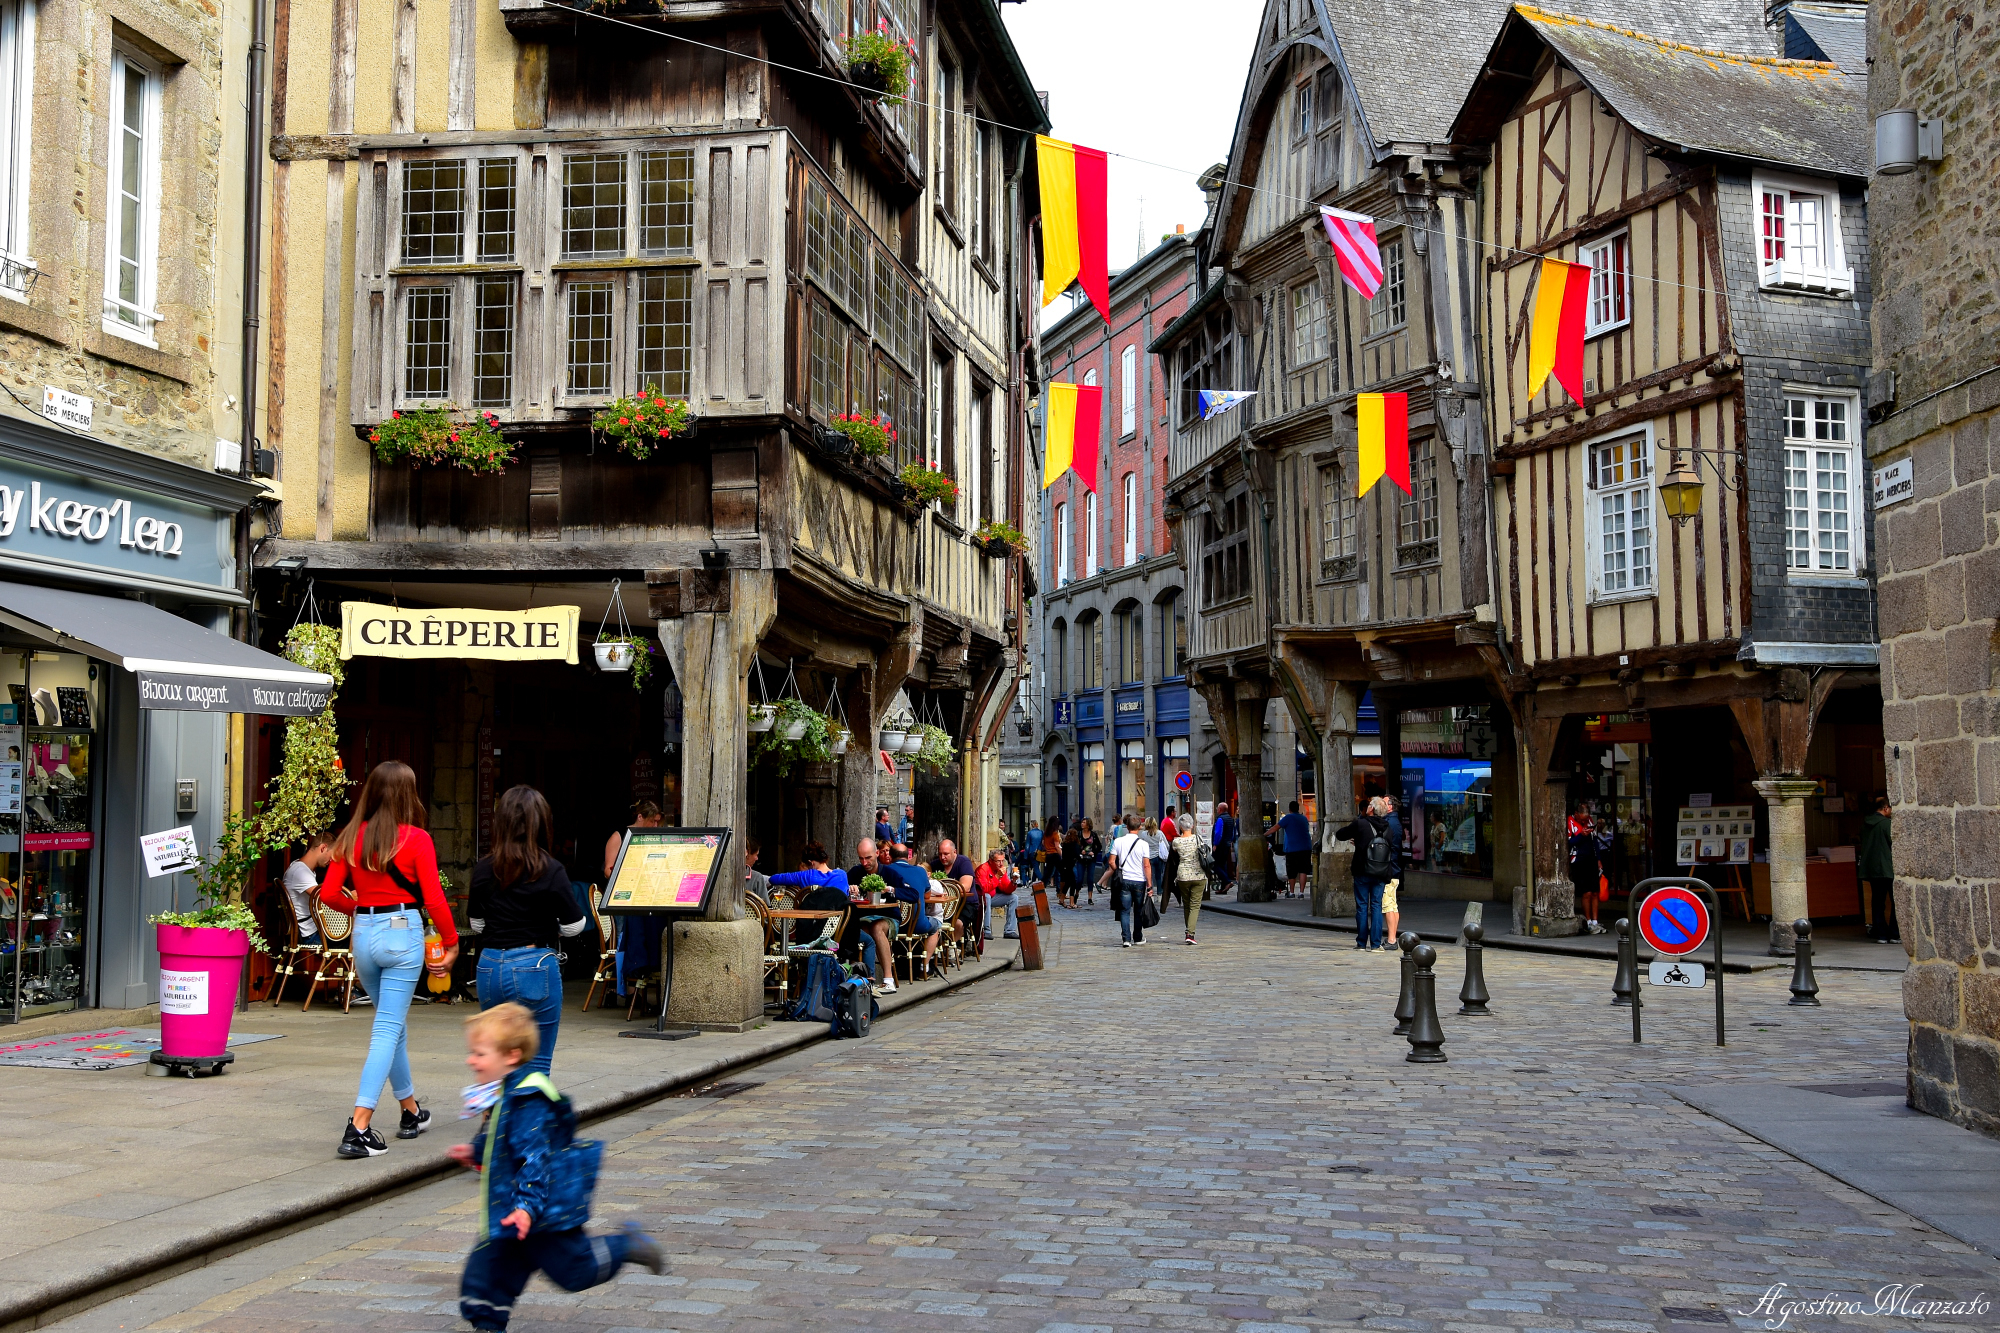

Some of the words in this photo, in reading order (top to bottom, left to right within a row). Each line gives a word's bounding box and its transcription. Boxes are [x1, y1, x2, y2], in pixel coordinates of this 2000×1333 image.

[61, 395, 79, 407] PLACE
[45, 404, 58, 416] DES
[61, 409, 90, 426] MERCIERS
[1885, 468, 1899, 480] PLACE
[1875, 490, 1884, 502] DES
[1887, 480, 1912, 497] MERCIERS
[0, 485, 25, 537] y
[360, 614, 560, 648] CRÊPERIE
[141, 679, 183, 702] Bijoux
[186, 685, 230, 709] argent
[253, 686, 285, 707] Bijoux
[287, 687, 327, 711] celtiques
[1396, 710, 1443, 724] PHARMACIE
[635, 758, 652, 766] CAFE
[634, 769, 655, 777] LAIT
[143, 836, 167, 846] BIJOUX
[167, 830, 190, 841] ARGENT
[157, 842, 181, 852] PIERRES
[163, 992, 198, 1000] NATURELLES
